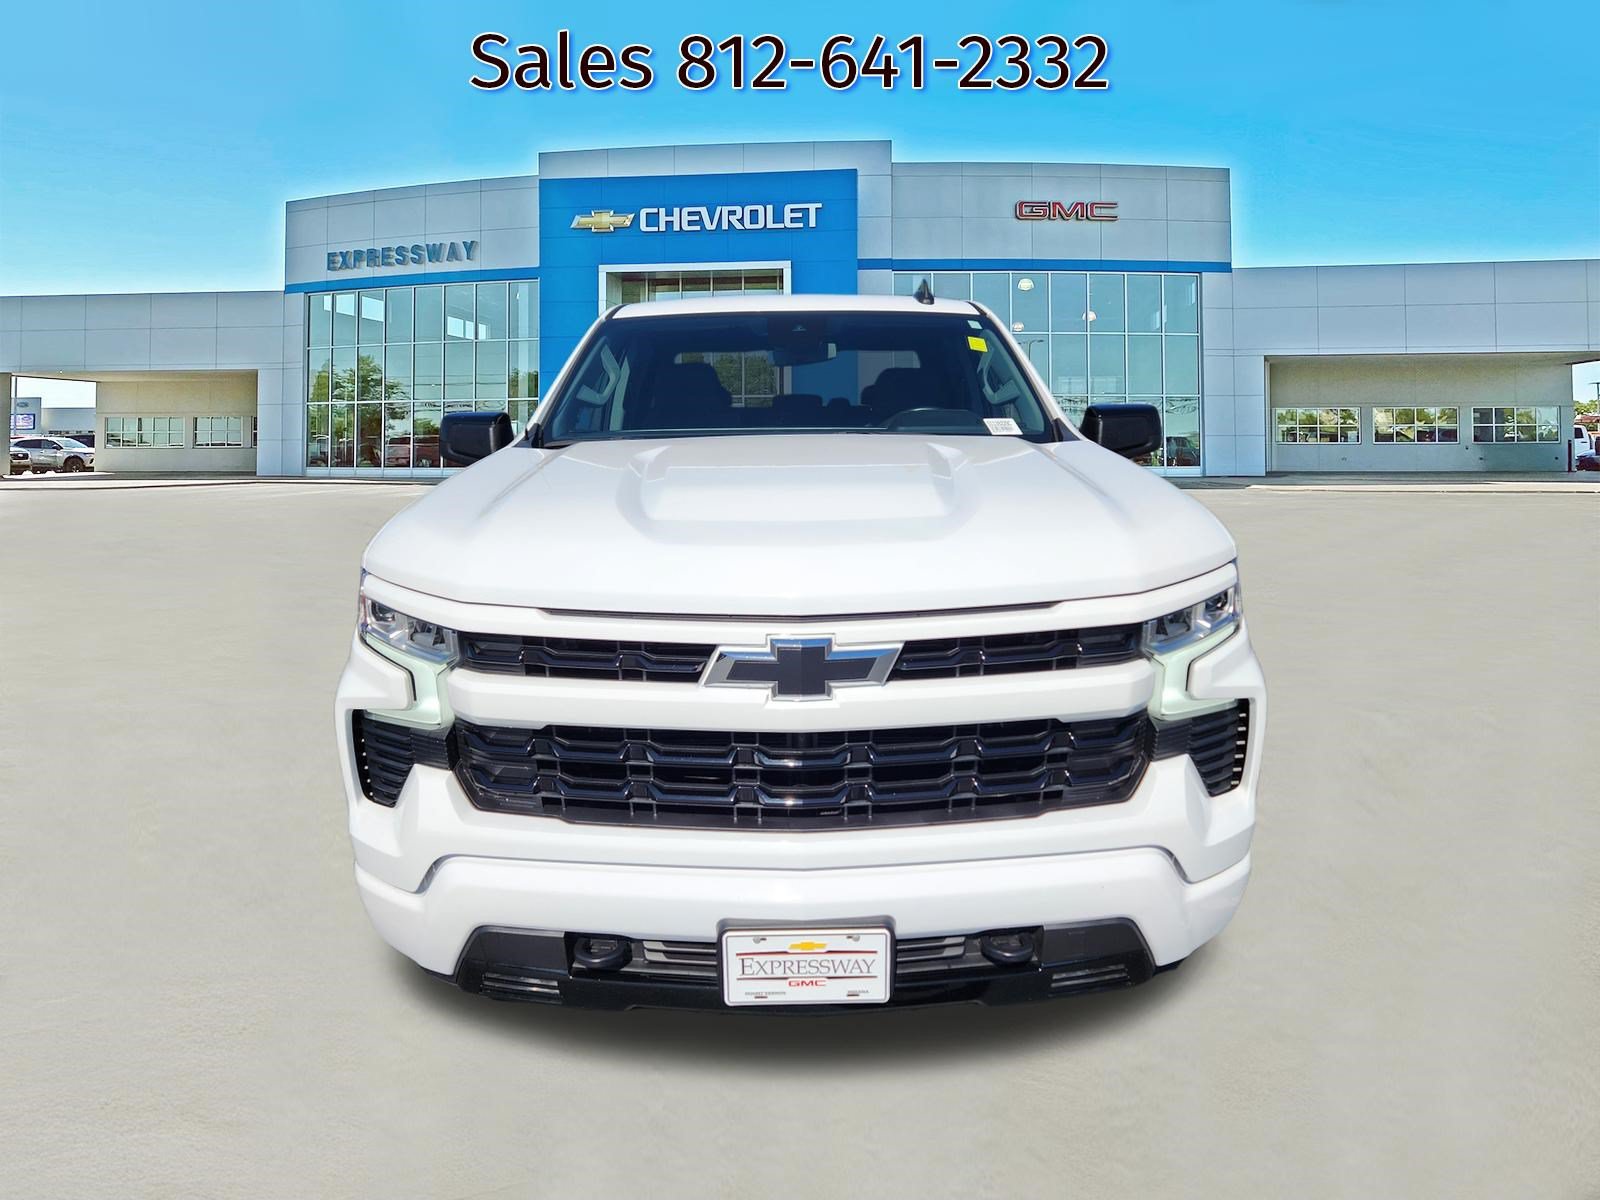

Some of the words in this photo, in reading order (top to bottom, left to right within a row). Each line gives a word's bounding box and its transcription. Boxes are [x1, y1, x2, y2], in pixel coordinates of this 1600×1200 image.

[639, 202, 823, 232] CHEVROLET
[1015, 200, 1119, 221] GMC
[327, 240, 479, 271] EXPRESSWAY
[740, 957, 876, 976] EXPRESSWAY
[788, 979, 827, 987] GMC
